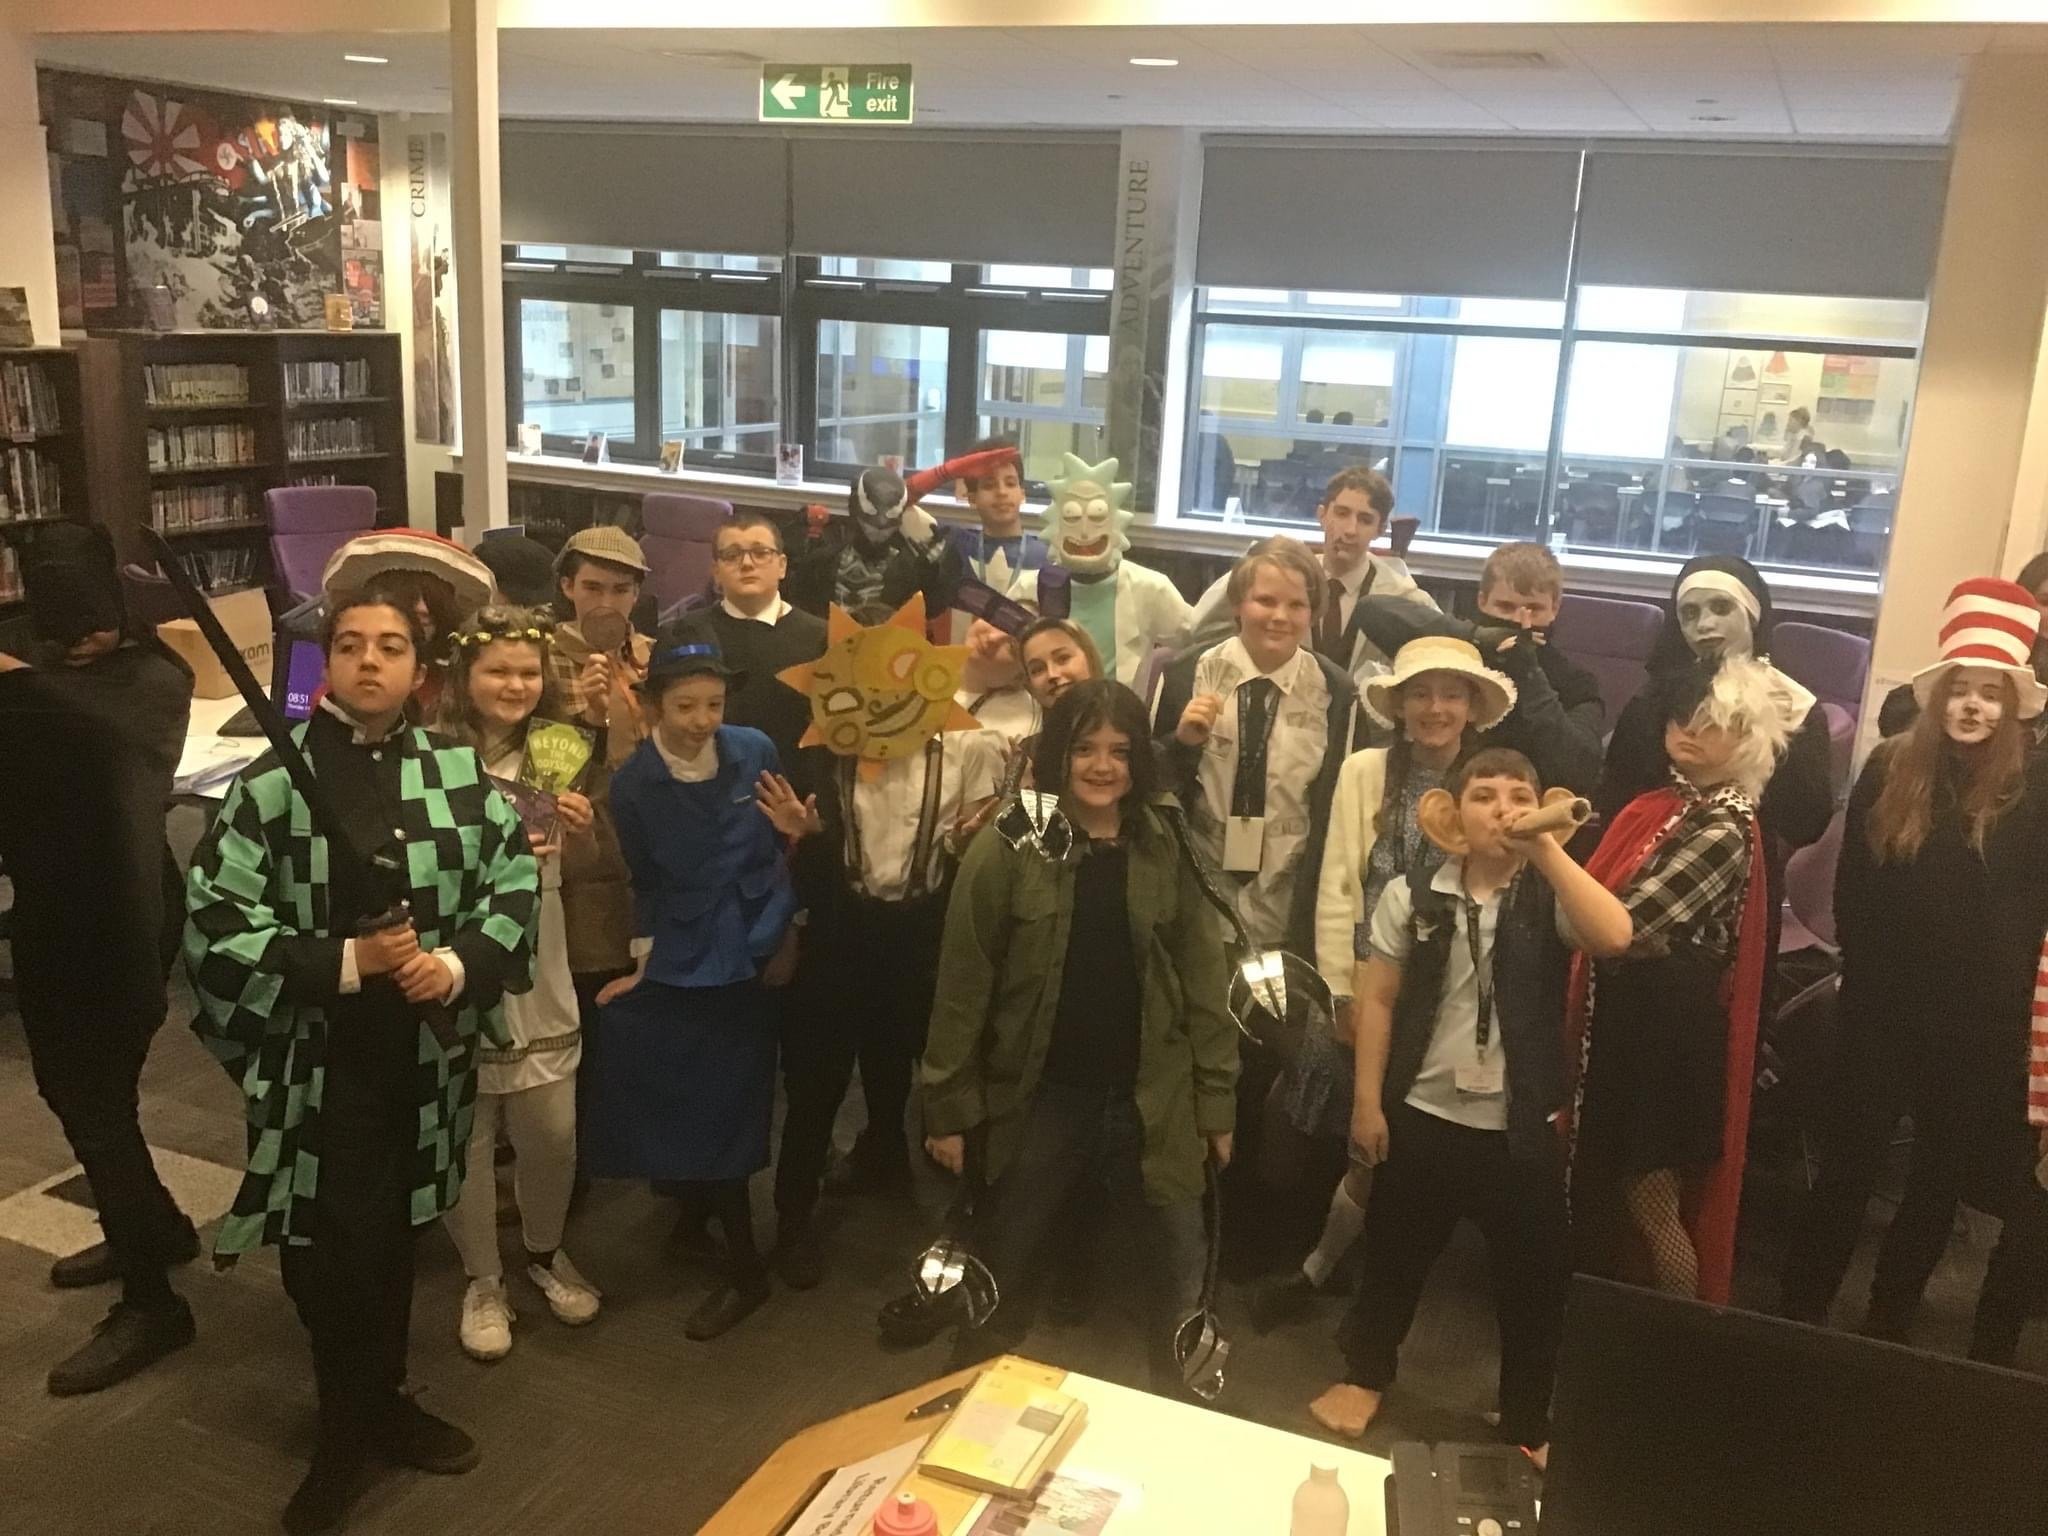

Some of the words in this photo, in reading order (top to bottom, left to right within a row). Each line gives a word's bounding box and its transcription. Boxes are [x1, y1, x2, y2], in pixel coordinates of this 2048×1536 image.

[866, 72, 900, 90] Fire
[866, 95, 898, 112] exit
[409, 141, 426, 218] CRIME
[1119, 159, 1150, 333] ADVENTURE
[532, 736, 586, 760] BEYOND
[550, 749, 566, 761] THE
[536, 758, 577, 775] ODYSSEY
